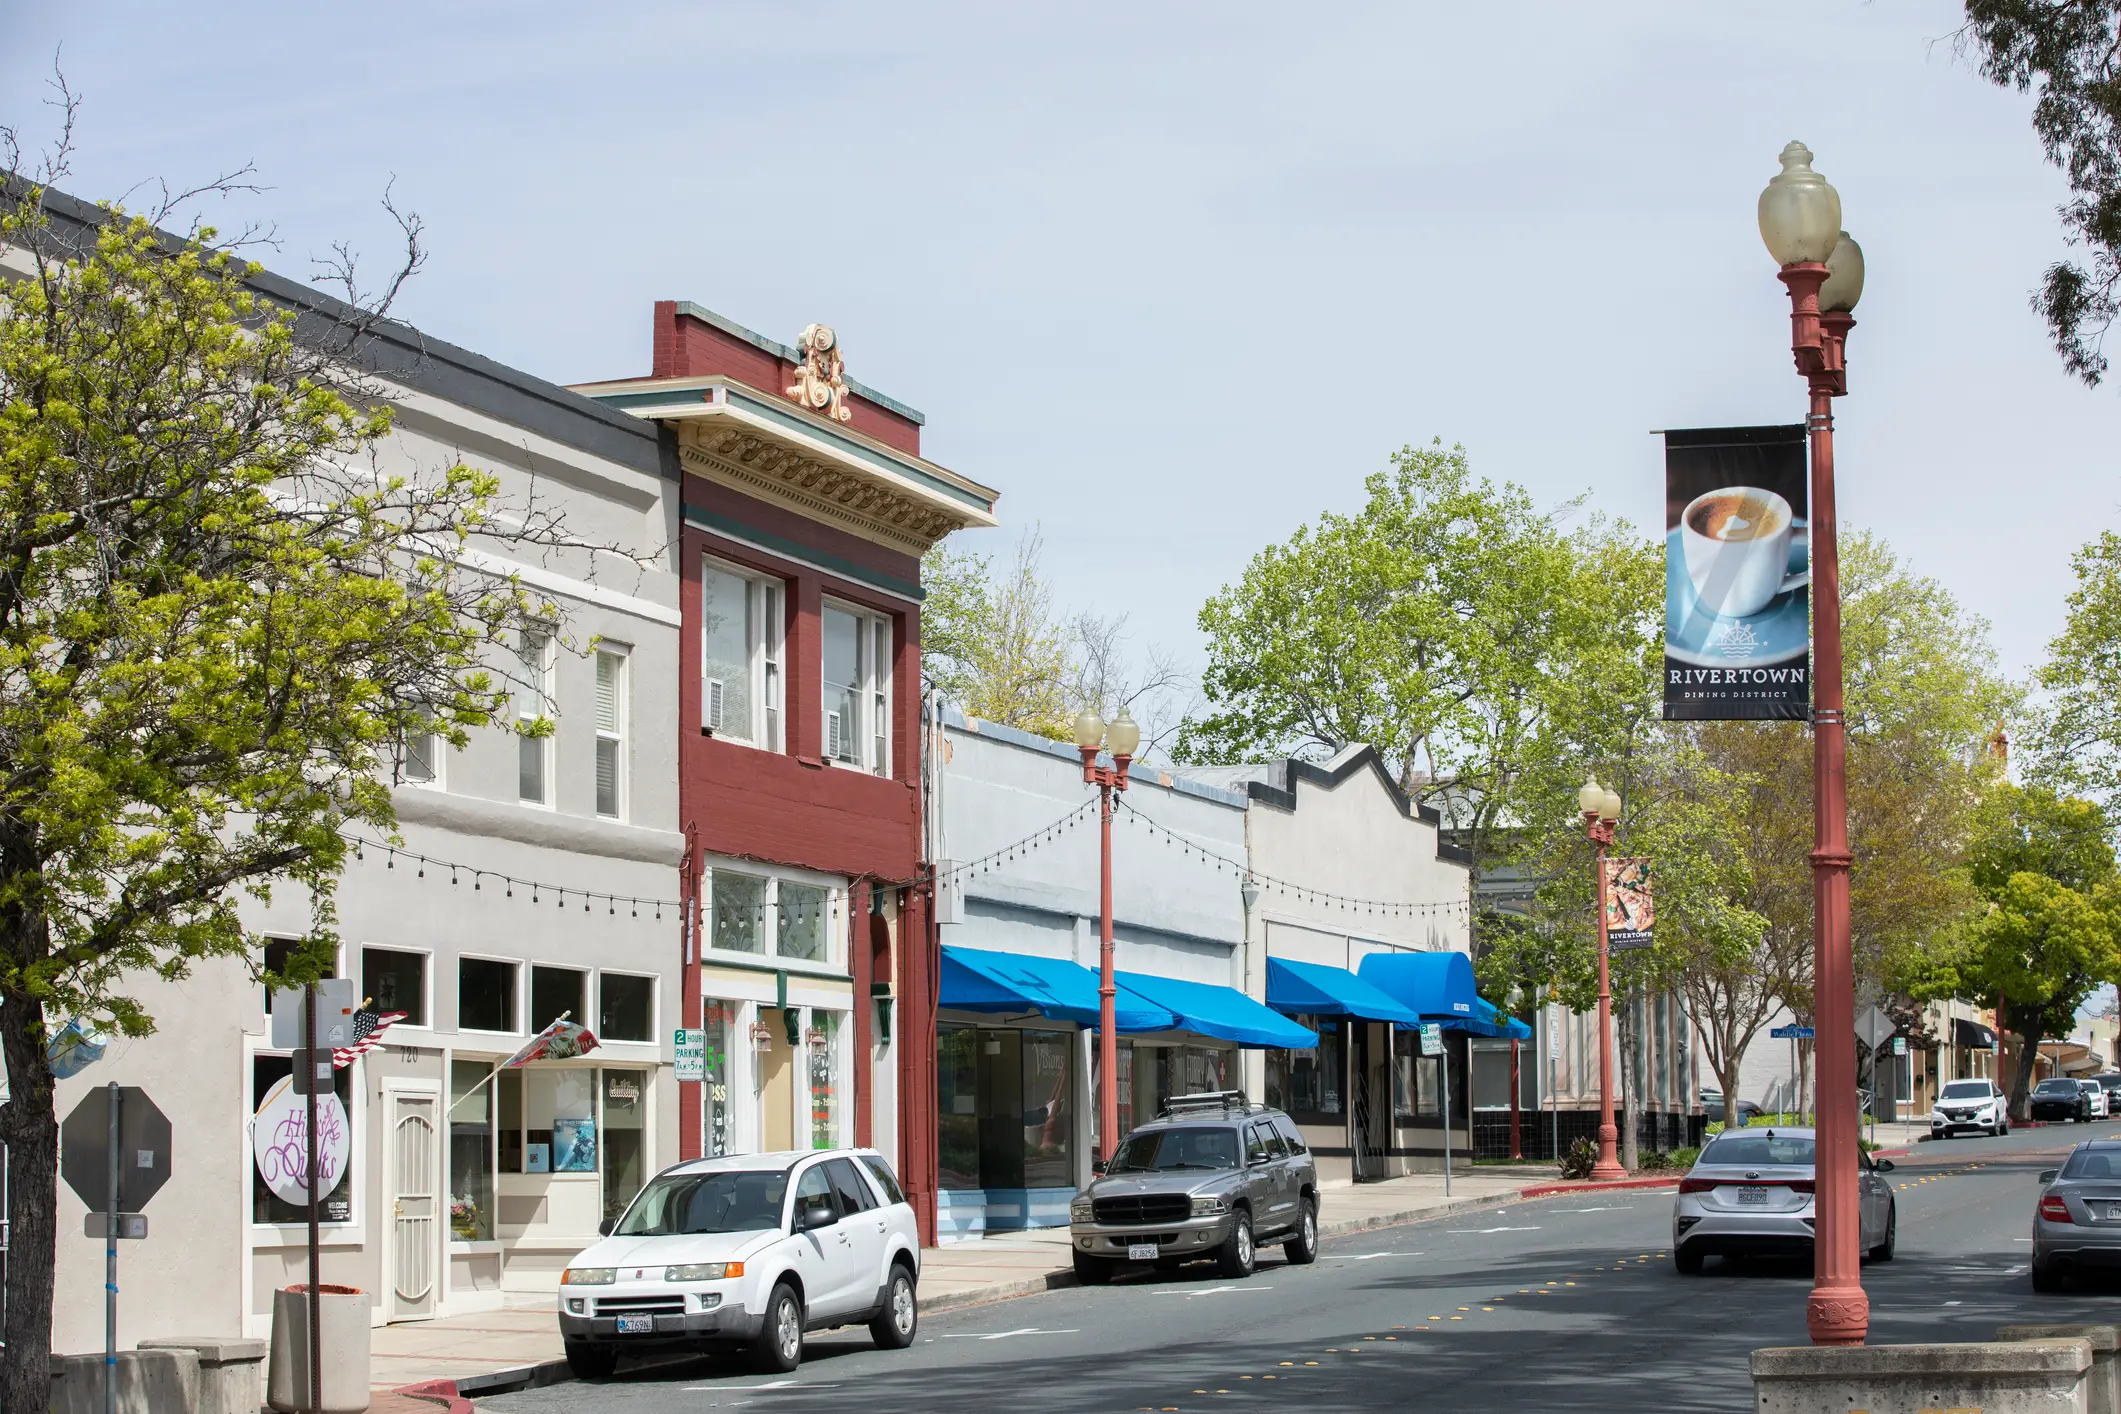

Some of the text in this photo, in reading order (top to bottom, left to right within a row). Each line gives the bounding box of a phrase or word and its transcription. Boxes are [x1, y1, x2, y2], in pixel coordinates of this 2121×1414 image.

[1669, 669, 1805, 684] RIVERTOWN
[1610, 931, 1653, 940] RIVERTOWN
[677, 1031, 703, 1043] 2 HOUR
[400, 1046, 418, 1063] 720
[676, 1049, 704, 1059] PARKING
